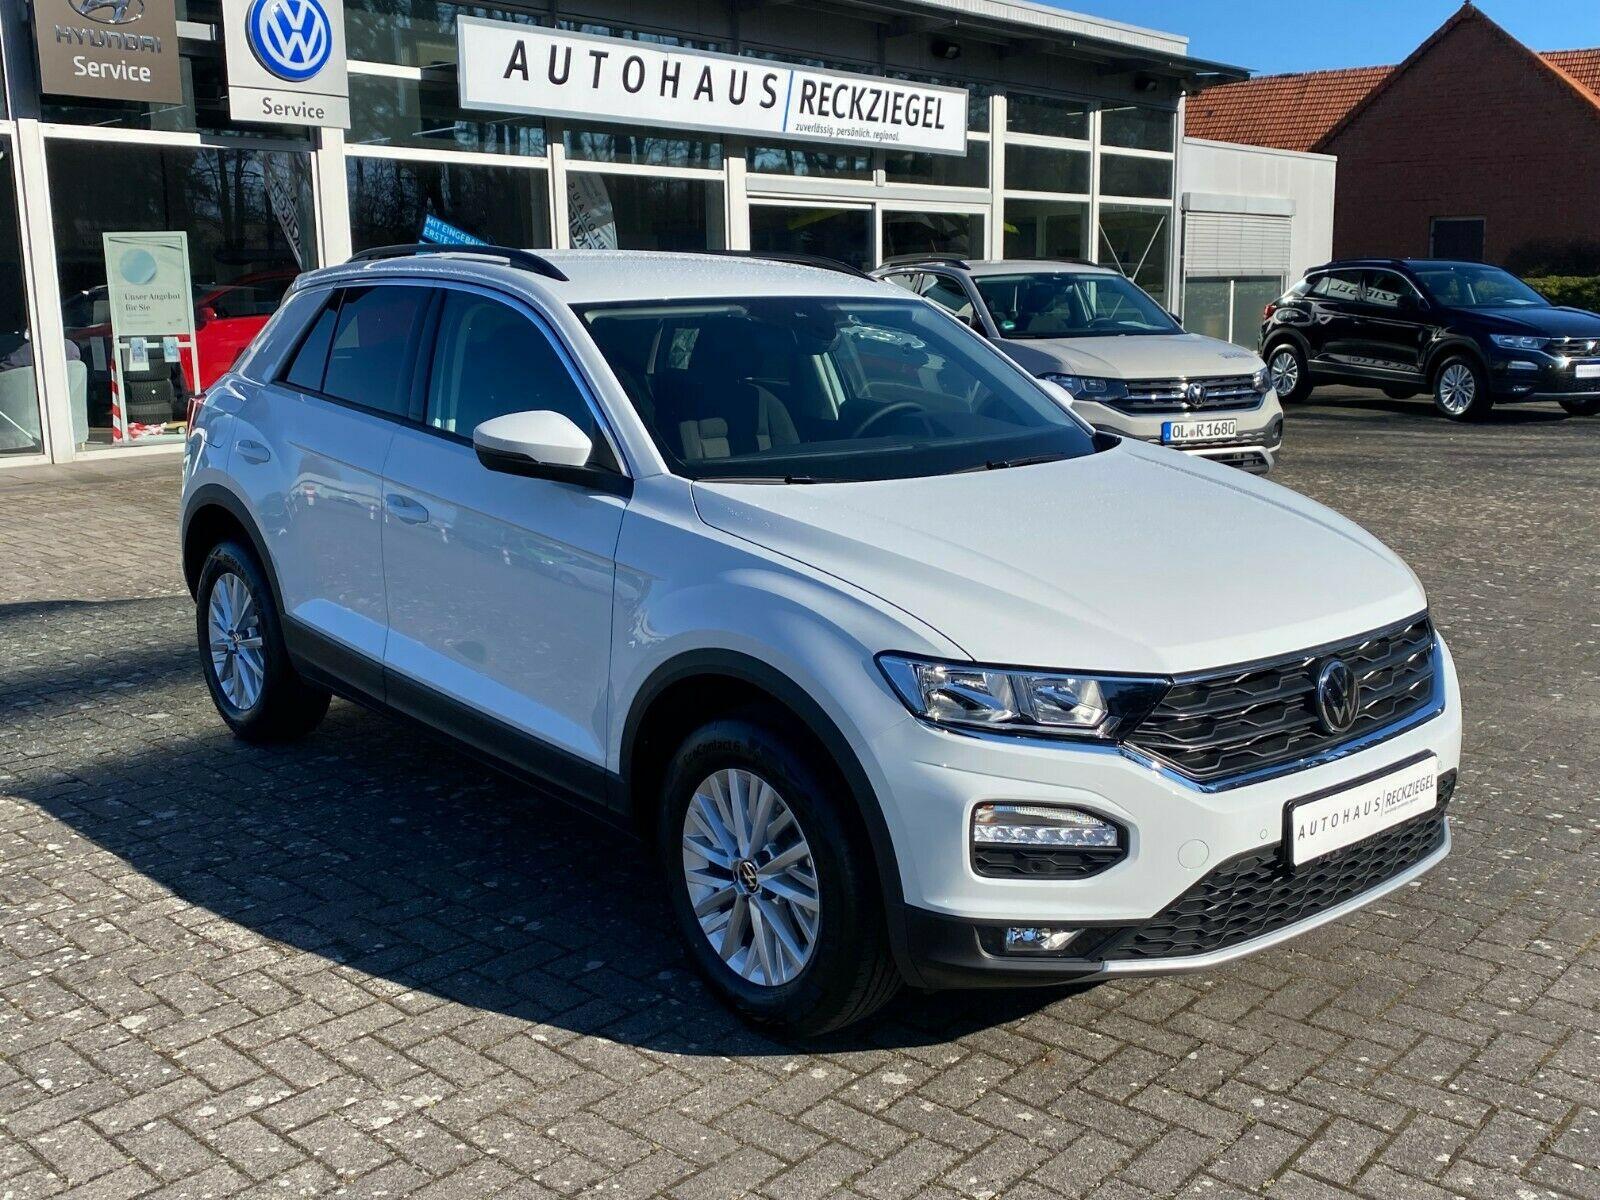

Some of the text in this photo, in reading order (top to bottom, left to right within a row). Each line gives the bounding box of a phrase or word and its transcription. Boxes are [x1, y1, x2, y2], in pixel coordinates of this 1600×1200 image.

[55, 24, 162, 53] HYUNDAI
[73, 55, 151, 82] Service
[503, 39, 945, 130] AUTOHAUS RECKZIEGEL
[262, 96, 325, 119] Service
[795, 122, 900, 142] zuverlässig. persönlich. regional.
[426, 216, 441, 230] MIT
[124, 292, 180, 301] Unser Angebot
[1172, 421, 1235, 438] OL R 1680
[1298, 797, 1381, 841] AUTOHAUS
[1385, 774, 1434, 807] RECKZIEGEL
